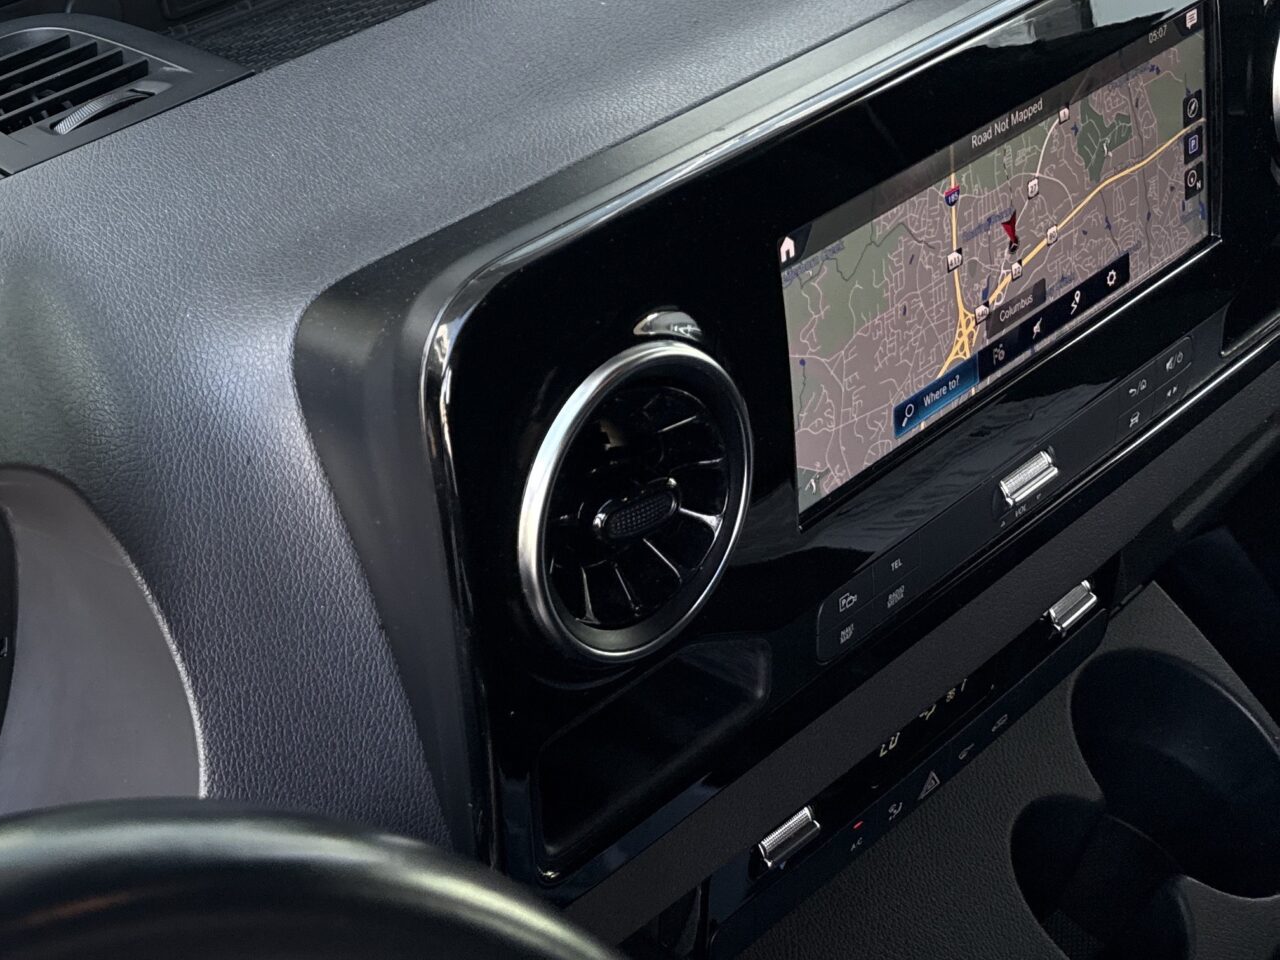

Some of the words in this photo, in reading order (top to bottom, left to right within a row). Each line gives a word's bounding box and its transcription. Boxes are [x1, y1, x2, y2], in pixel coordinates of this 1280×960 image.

[971, 126, 993, 149] Road
[994, 120, 1010, 136] Not
[1011, 98, 1043, 126] Mapped
[999, 294, 1034, 322] Columbus
[923, 386, 948, 407] Where
[948, 374, 960, 391] to?
[890, 558, 903, 571] TEL
